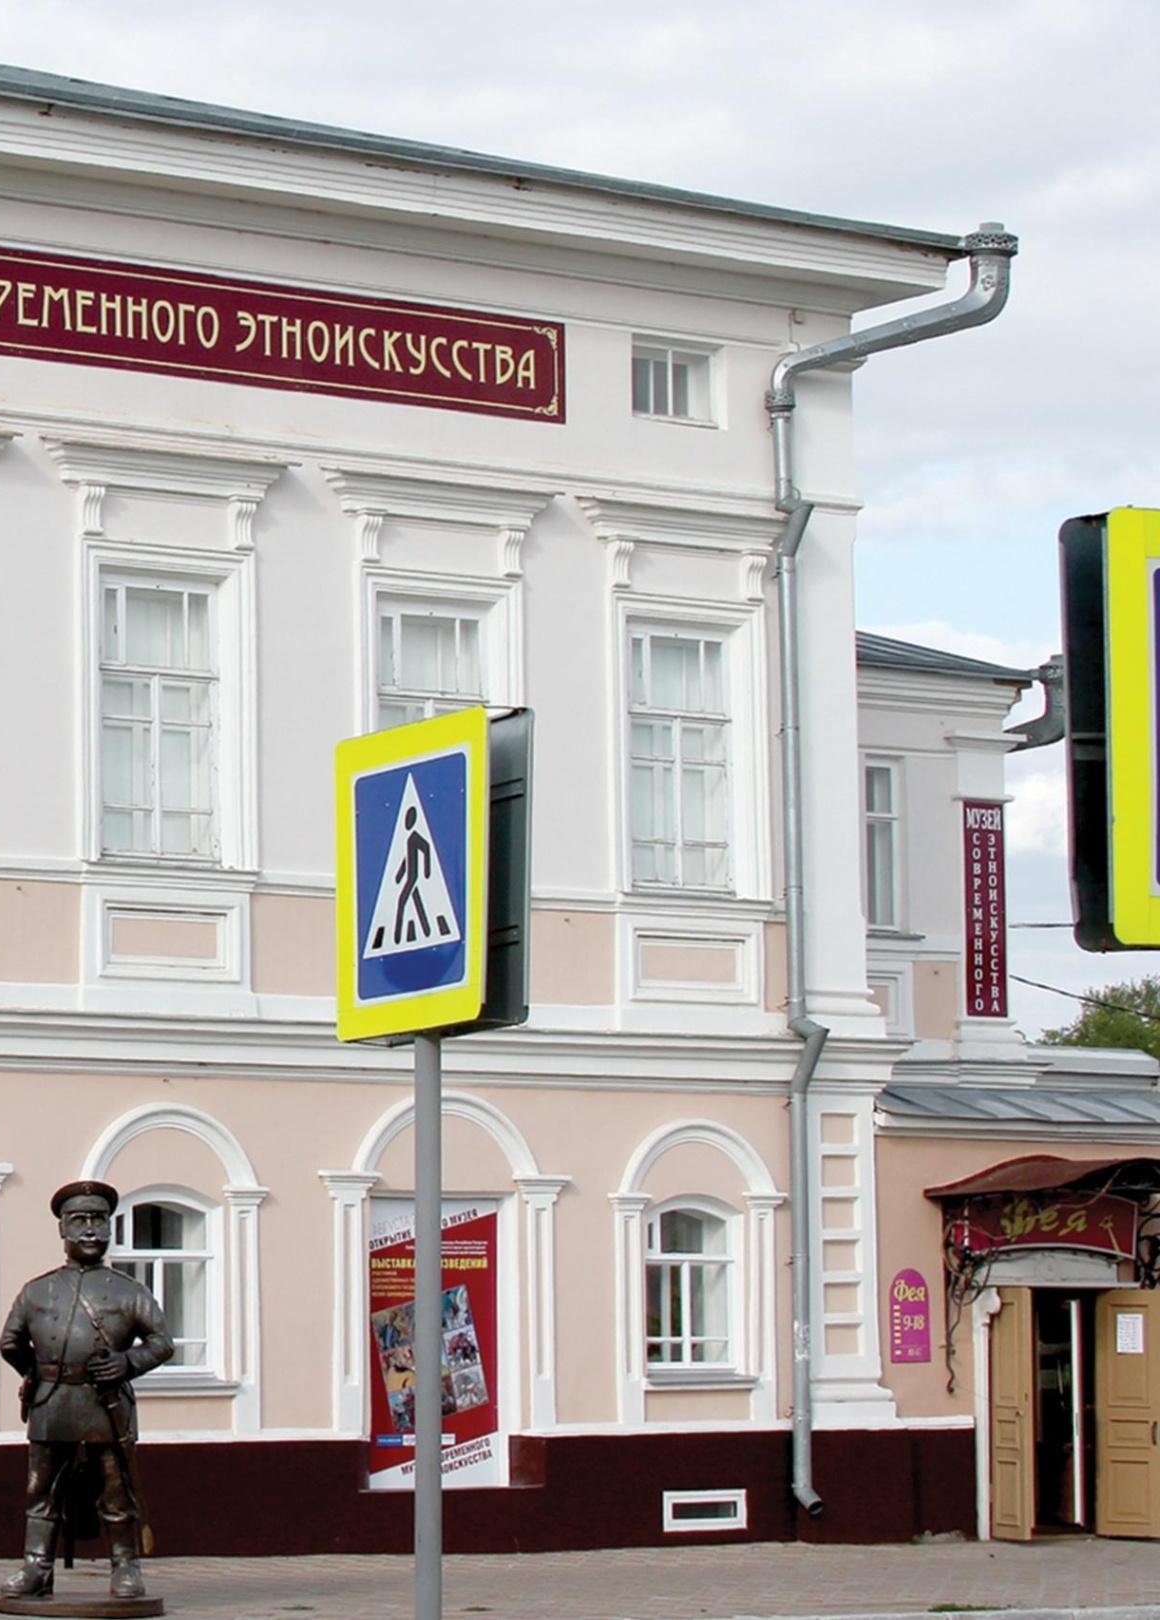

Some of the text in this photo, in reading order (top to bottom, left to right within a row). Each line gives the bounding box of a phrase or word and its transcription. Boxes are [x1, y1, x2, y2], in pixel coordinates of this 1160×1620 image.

[236, 313, 537, 390] ЭТНОИСКУССТВА
[966, 808, 1001, 831] МУЗЕЙ
[972, 832, 984, 1011] СОВРЕМЕННОГО
[987, 833, 1000, 1012] ЭТНОИСКУССТВА
